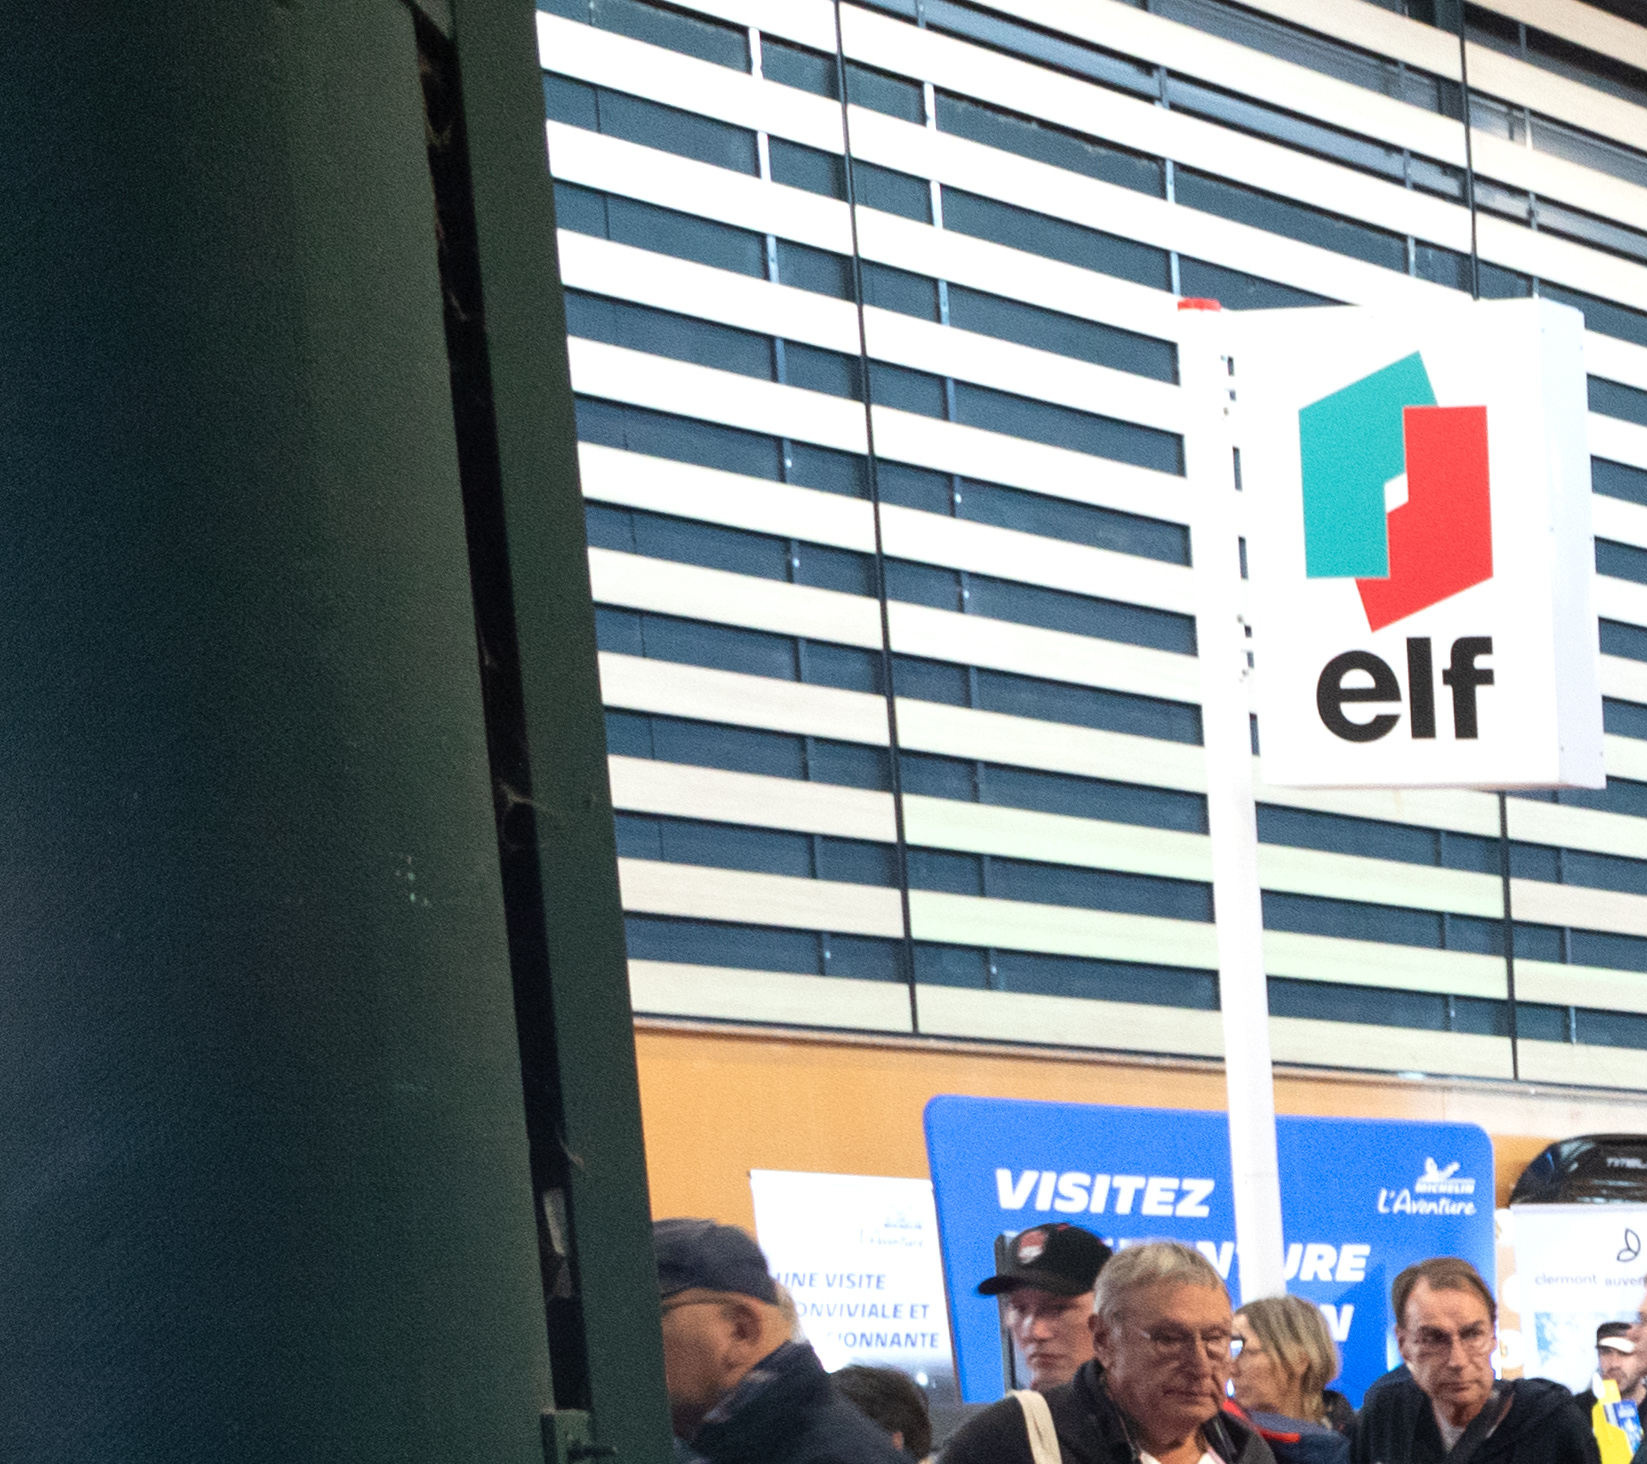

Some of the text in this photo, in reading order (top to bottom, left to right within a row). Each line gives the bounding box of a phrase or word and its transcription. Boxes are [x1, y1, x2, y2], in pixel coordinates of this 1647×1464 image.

[1316, 636, 1495, 744] elf
[995, 1168, 1215, 1218] VISITEZ
[1378, 1189, 1478, 1216] L'Aventure
[776, 1272, 887, 1290] UNE VISITE
[1535, 1273, 1647, 1288] clermont auver
[799, 1301, 930, 1320] ONVIVIALE ET
